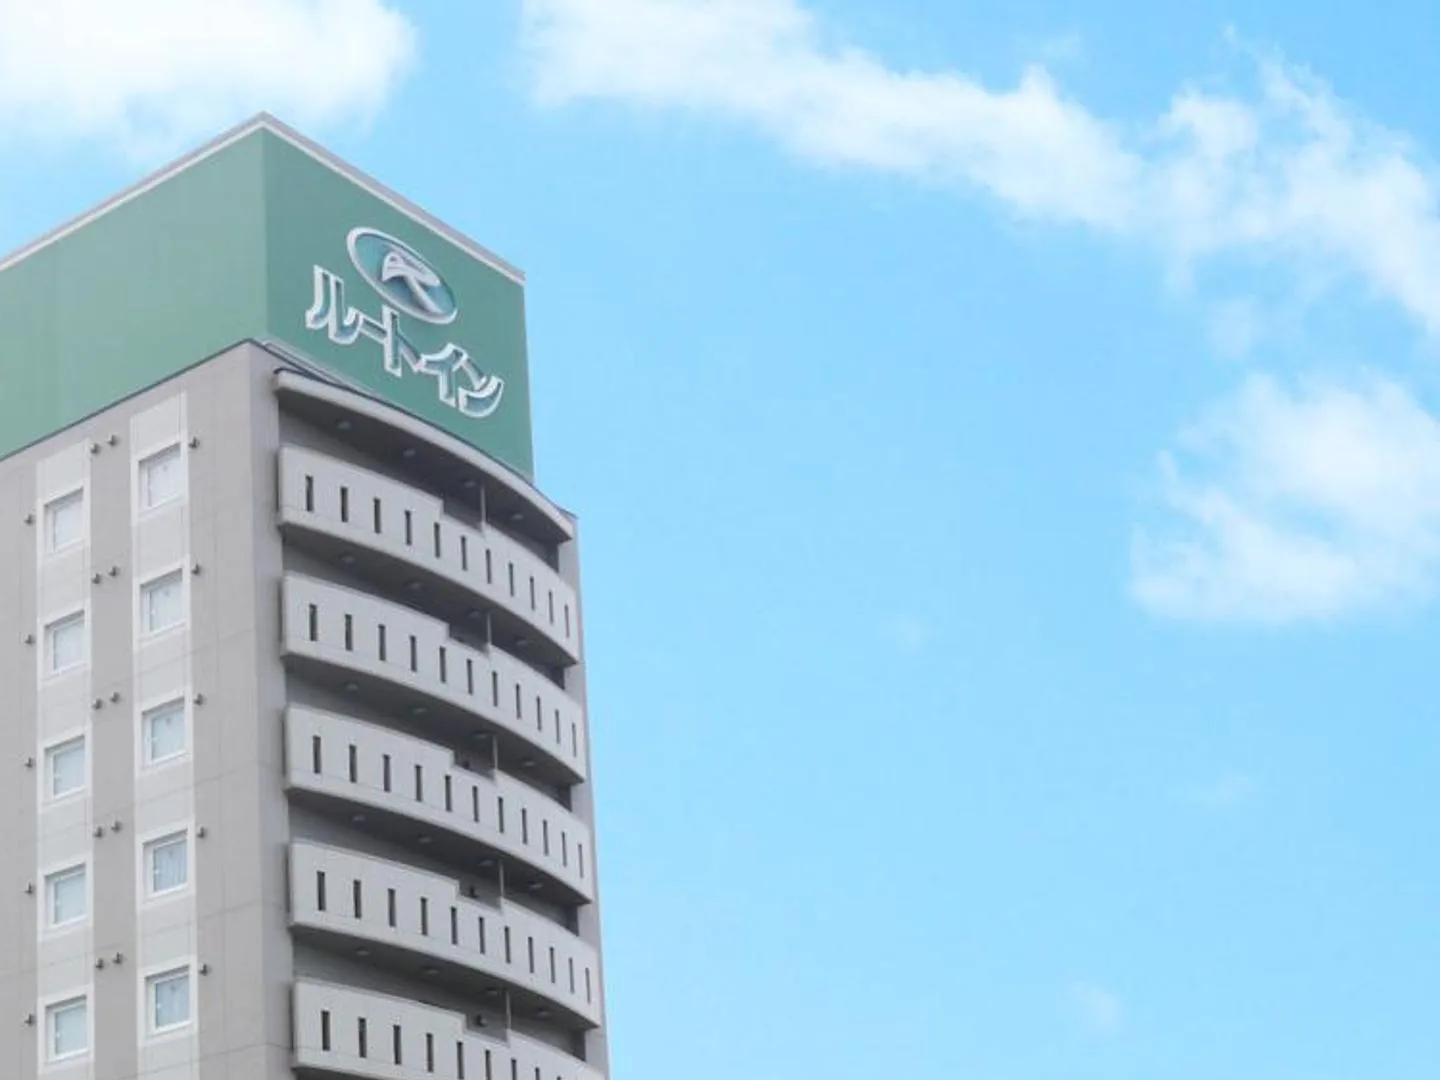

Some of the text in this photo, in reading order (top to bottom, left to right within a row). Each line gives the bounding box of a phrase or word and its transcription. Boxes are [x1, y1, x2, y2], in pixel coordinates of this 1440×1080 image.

[305, 265, 505, 418] ルートイン
